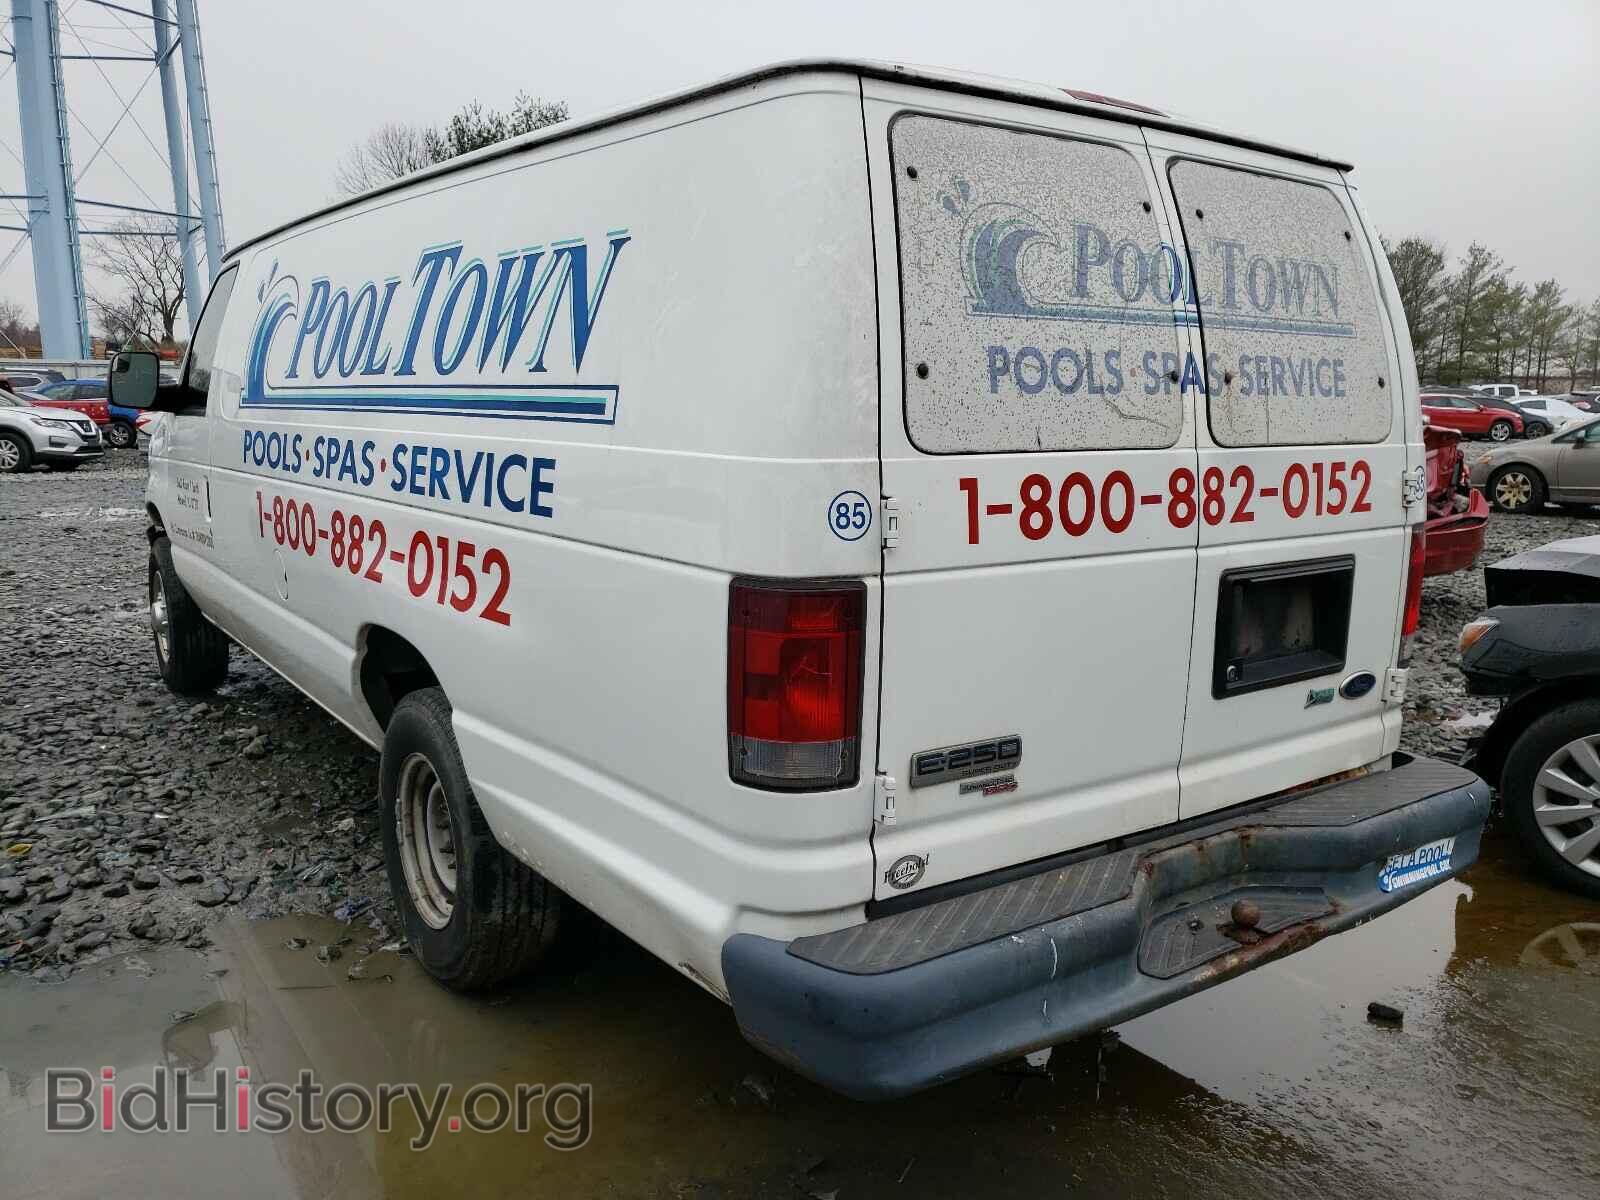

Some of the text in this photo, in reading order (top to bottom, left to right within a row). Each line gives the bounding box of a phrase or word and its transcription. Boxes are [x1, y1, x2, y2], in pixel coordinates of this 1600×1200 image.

[986, 345, 1346, 398] POOLS SPAS SERVICE
[243, 429, 556, 518] POOLS SPAS SERVICE
[835, 502, 866, 530] 85
[960, 460, 1373, 545] 1-800-882-0152
[257, 490, 512, 626] 1-800-882-0152
